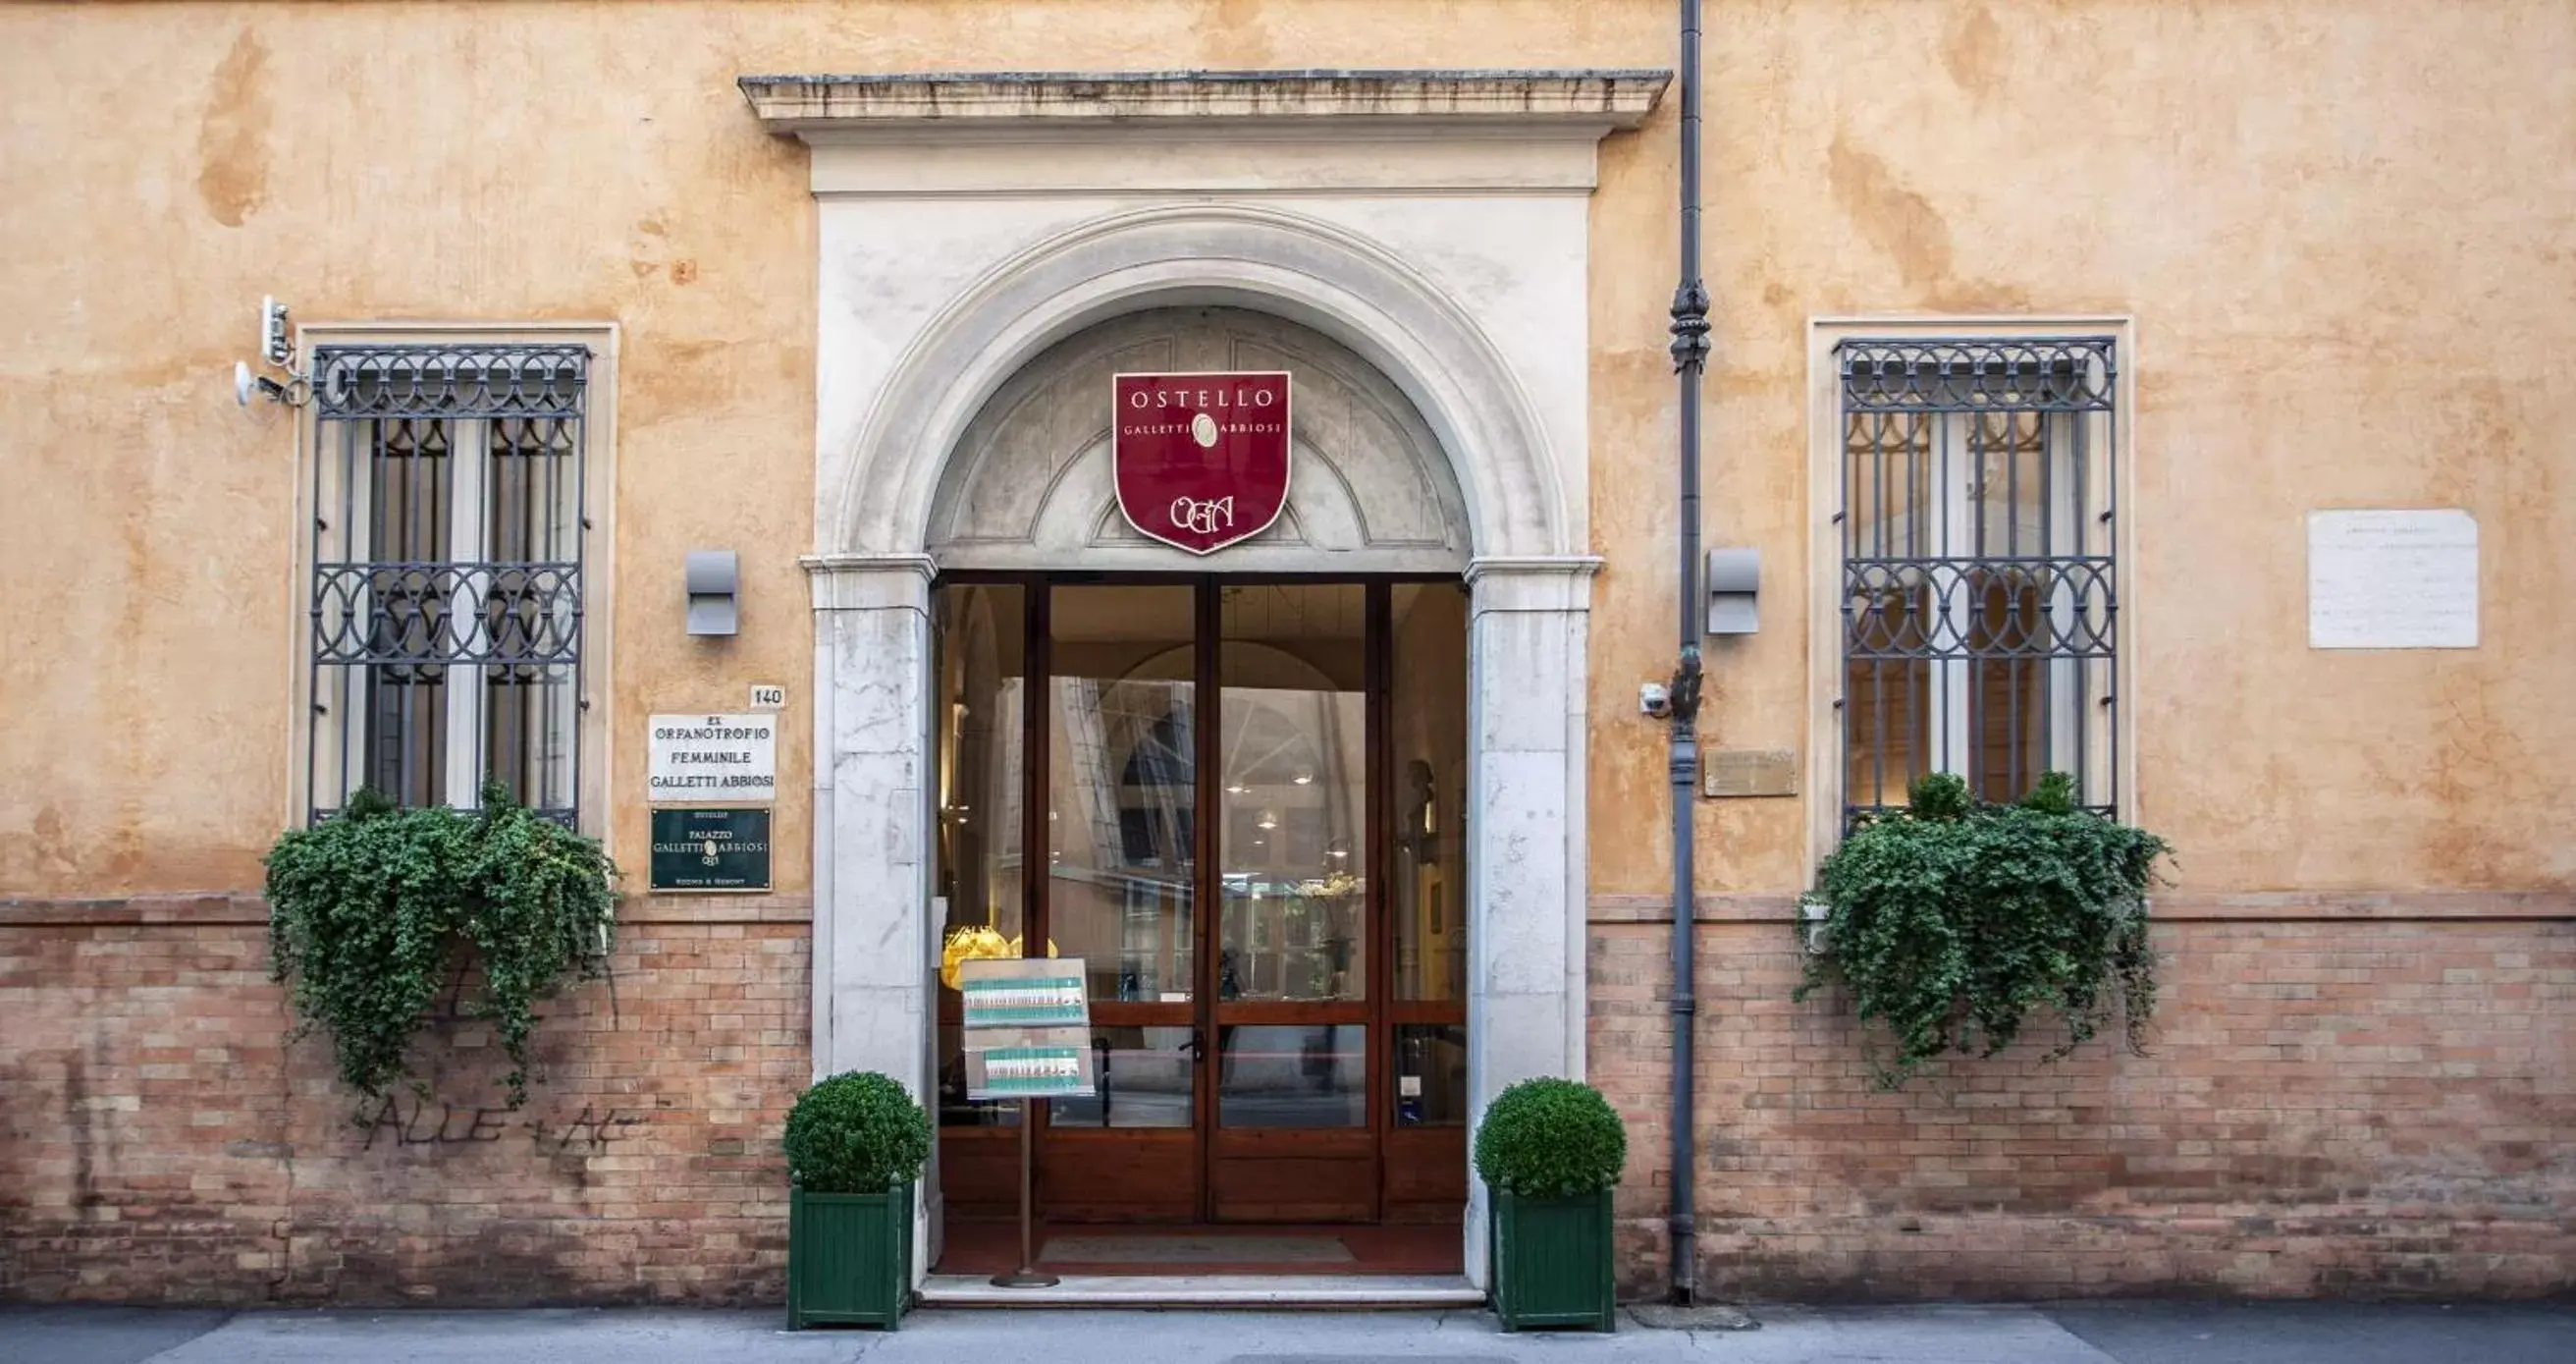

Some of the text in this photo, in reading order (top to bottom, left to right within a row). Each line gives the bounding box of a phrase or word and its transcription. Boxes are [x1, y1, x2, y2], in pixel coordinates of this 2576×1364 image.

[1131, 389, 1273, 409] OSTELLO
[1124, 423, 1280, 436] GALLETTI ABBIOSI
[755, 689, 781, 704] 140
[655, 728, 770, 740] ORFANOTROFIO
[671, 752, 752, 764] FEMMINILE
[650, 776, 774, 788] GALLETTI ABBIOSI
[689, 831, 732, 840] PALAZZO
[653, 843, 704, 853] GALLETTI
